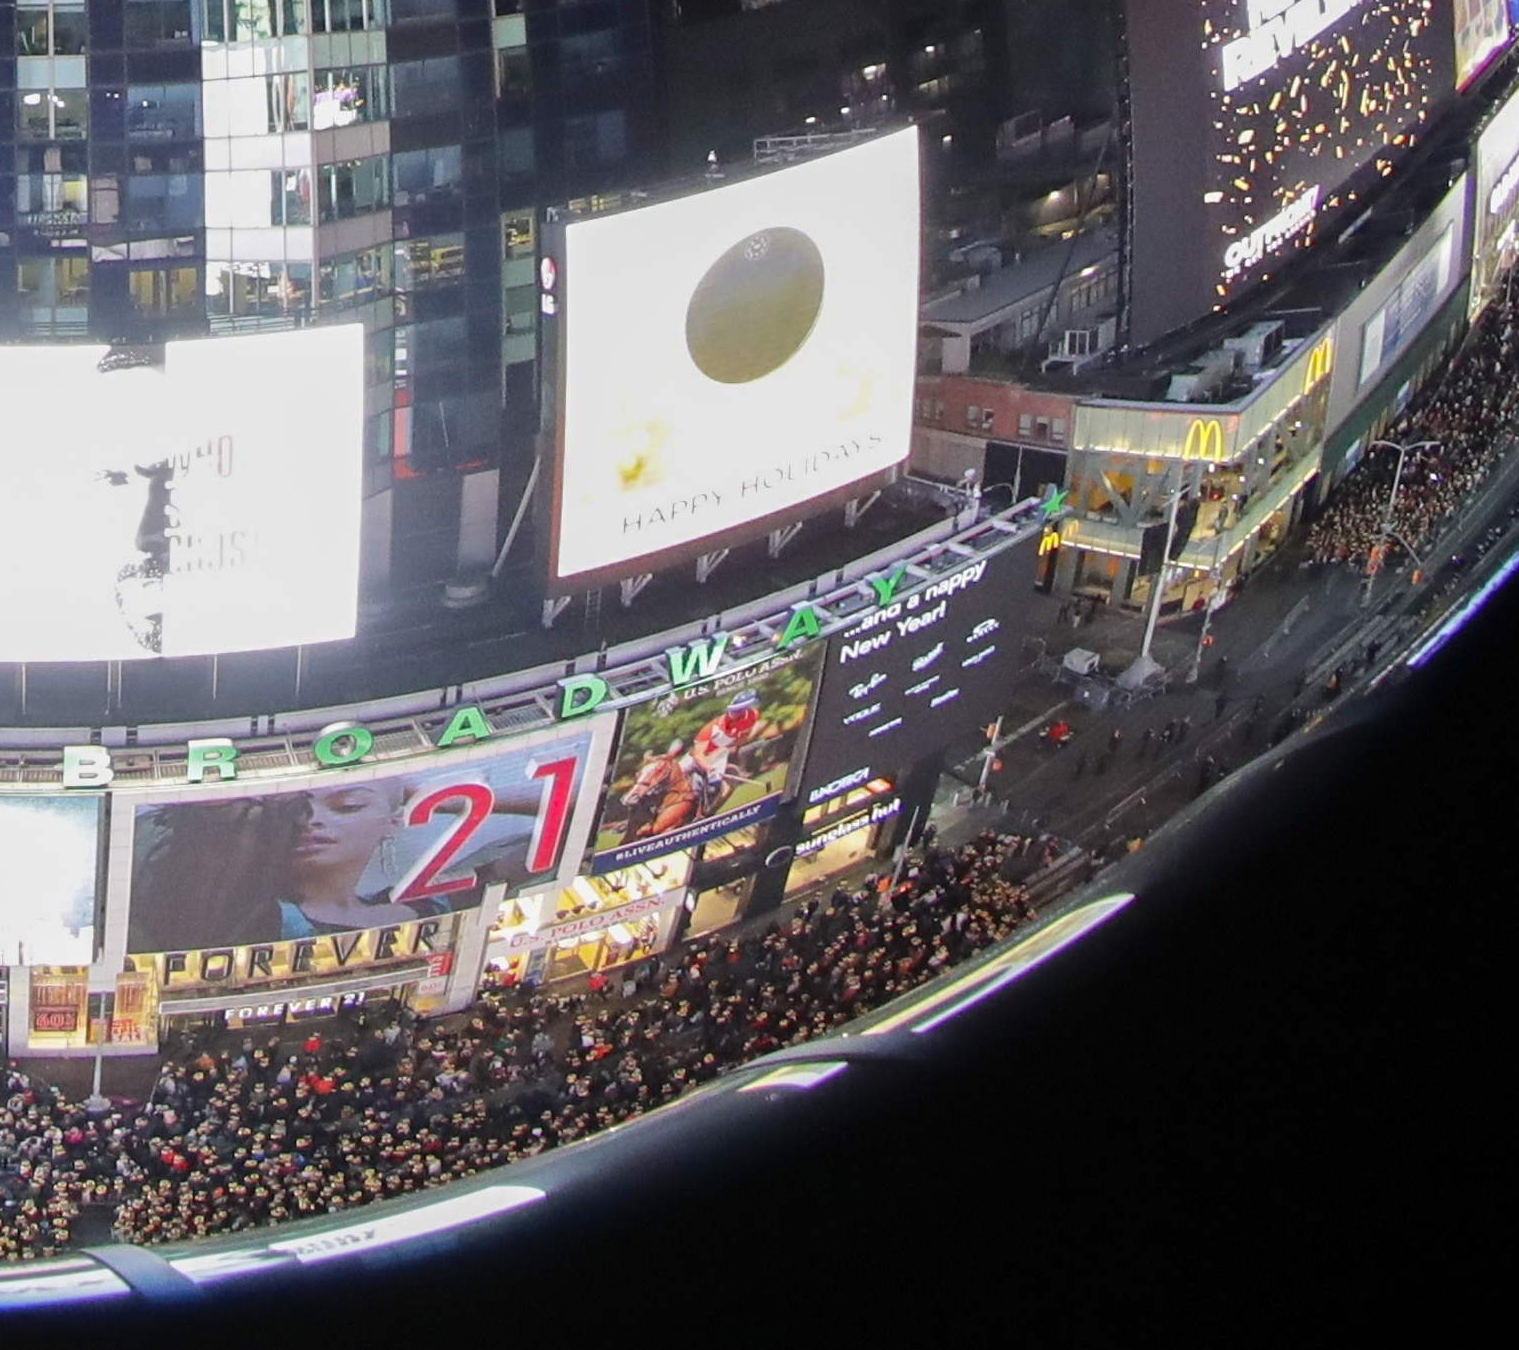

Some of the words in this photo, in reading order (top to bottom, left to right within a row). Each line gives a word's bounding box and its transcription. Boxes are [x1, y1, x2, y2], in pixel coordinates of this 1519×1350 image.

[622, 490, 723, 535] HAPPY
[740, 433, 882, 497] HOLIDAYS
[907, 594, 920, 609] a
[840, 631, 892, 664] New
[896, 601, 947, 637] Year!
[62, 565, 906, 788] BROADWAY
[713, 667, 758, 690] POLO
[391, 756, 576, 903] 21
[616, 804, 762, 861] #LIVEAUTHENTICALLY
[796, 815, 870, 855] sunglass
[872, 798, 901, 822] hut
[510, 933, 543, 948] U.S.
[551, 916, 604, 938] POLO
[607, 897, 666, 920] ASSN.
[164, 921, 440, 986] FOREVER
[224, 997, 334, 1021] FOREVER
